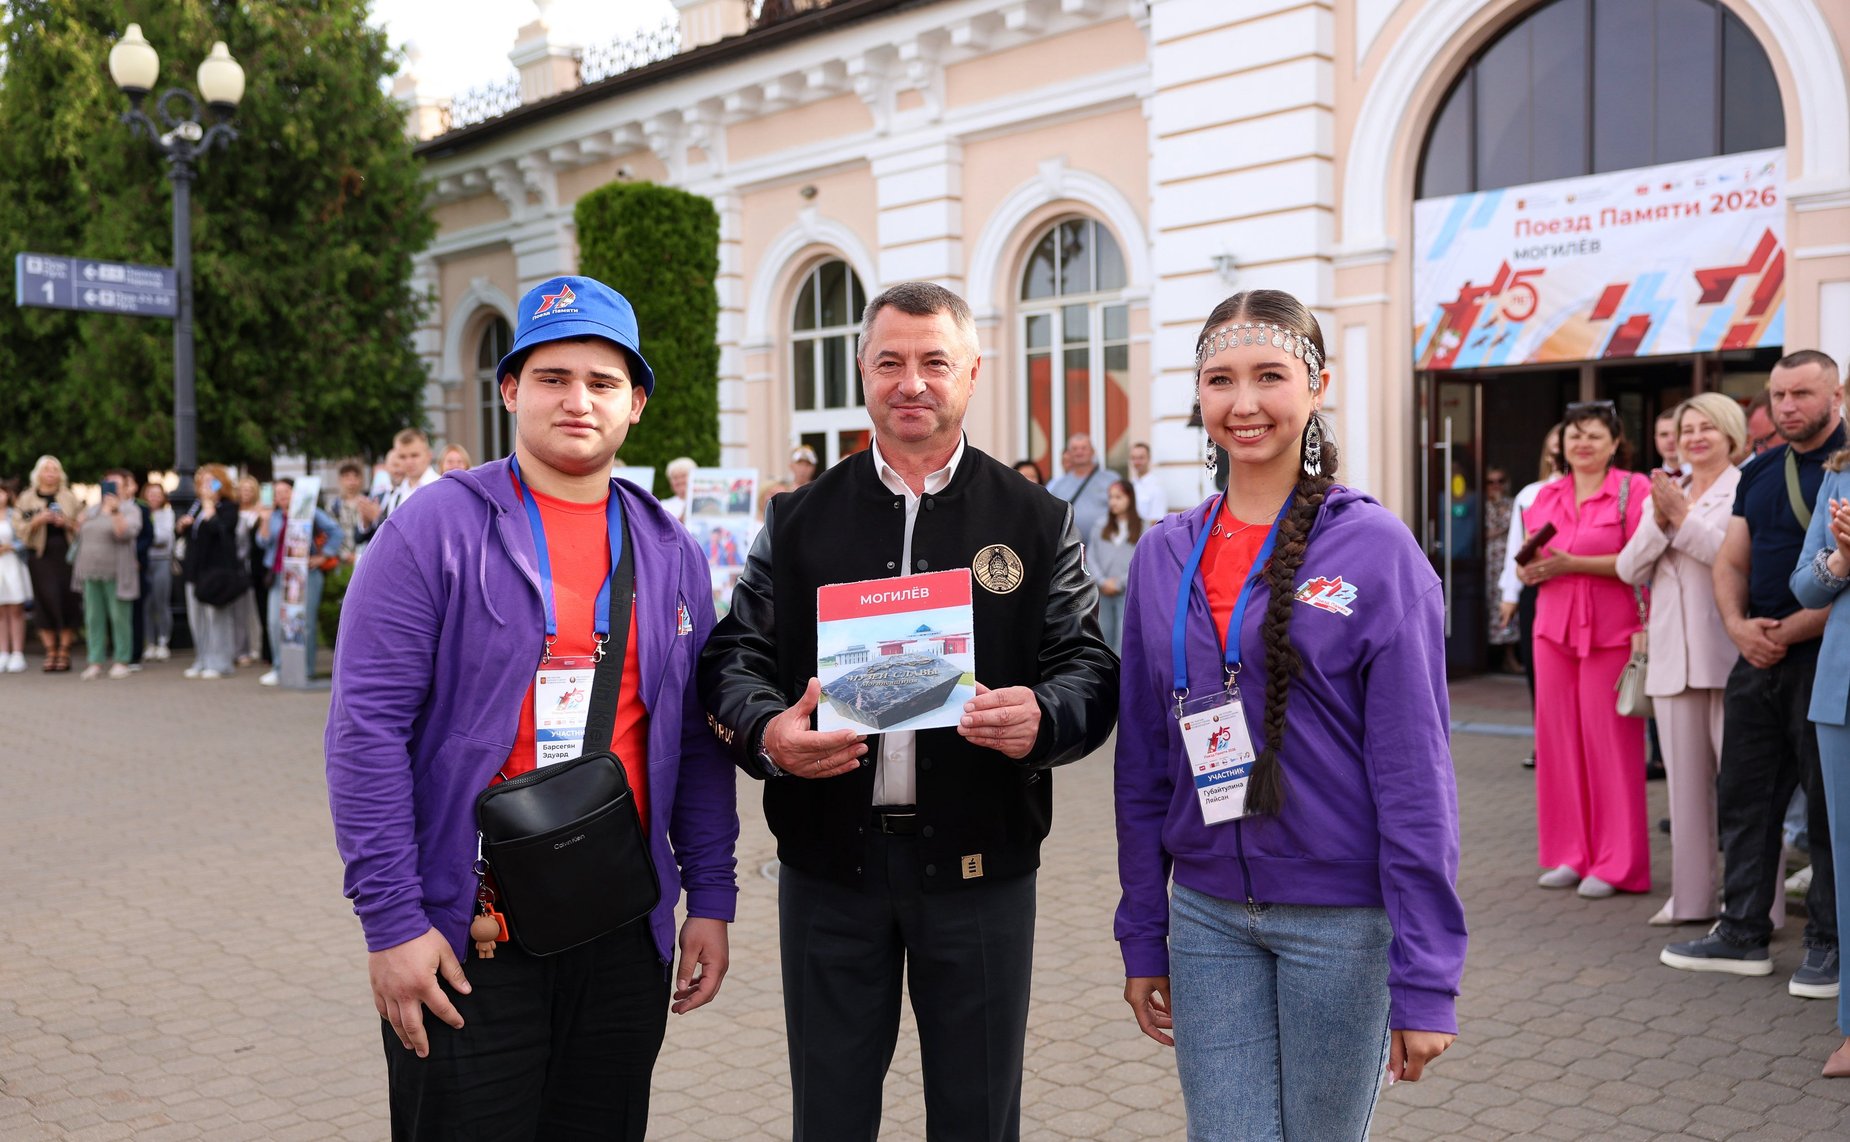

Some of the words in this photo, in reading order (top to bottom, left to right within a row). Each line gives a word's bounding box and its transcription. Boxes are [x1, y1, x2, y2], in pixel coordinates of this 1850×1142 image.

[1514, 214, 1592, 238] Поезд
[1600, 199, 1700, 227] Памяти
[1709, 185, 1777, 215] 2026
[1514, 239, 1600, 259] МОГИЛЁВ
[41, 280, 55, 304] 1
[859, 587, 930, 606] МОГИЛЁВ
[542, 743, 576, 751] Барсегян
[1208, 767, 1244, 781] УЧАСТНИК
